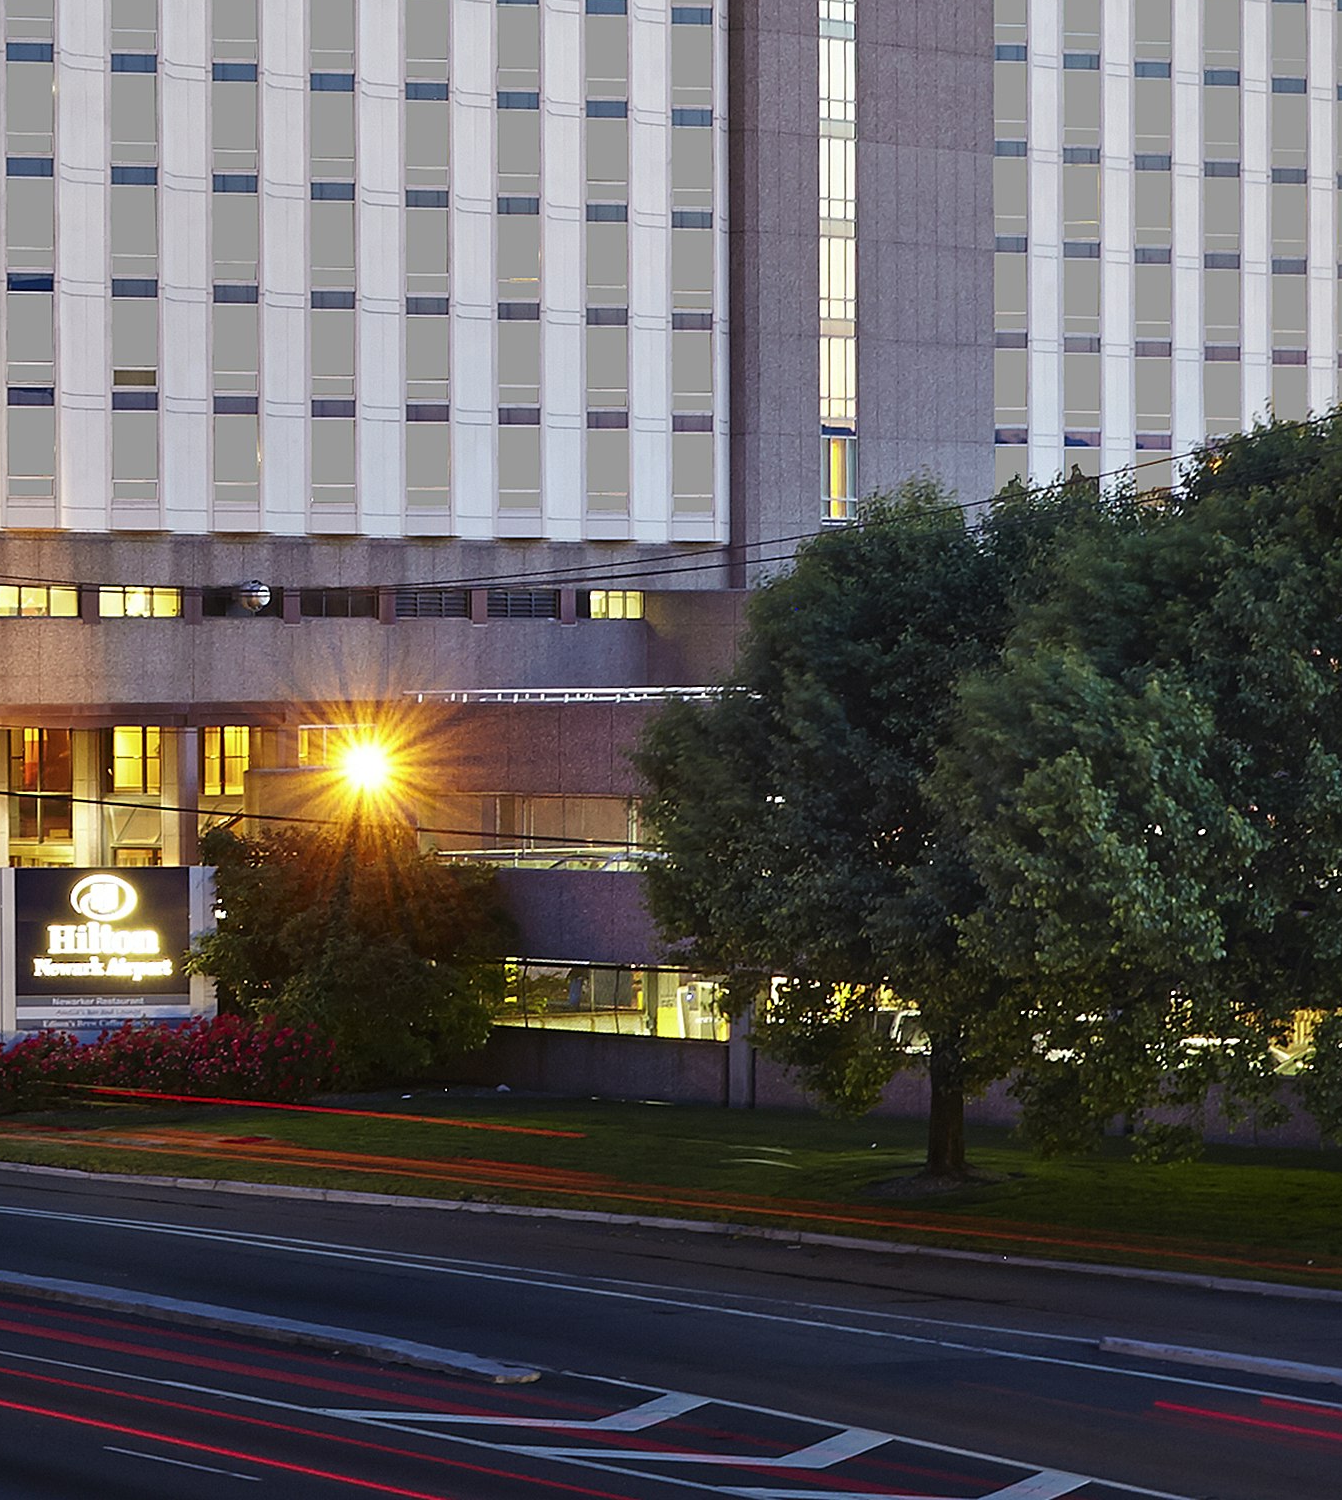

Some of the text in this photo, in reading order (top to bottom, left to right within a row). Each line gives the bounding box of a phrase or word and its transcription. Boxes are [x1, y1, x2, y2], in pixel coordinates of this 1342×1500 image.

[47, 921, 160, 954] Hilton
[33, 956, 173, 981] Newark Airport
[96, 997, 144, 1005] Restaurant
